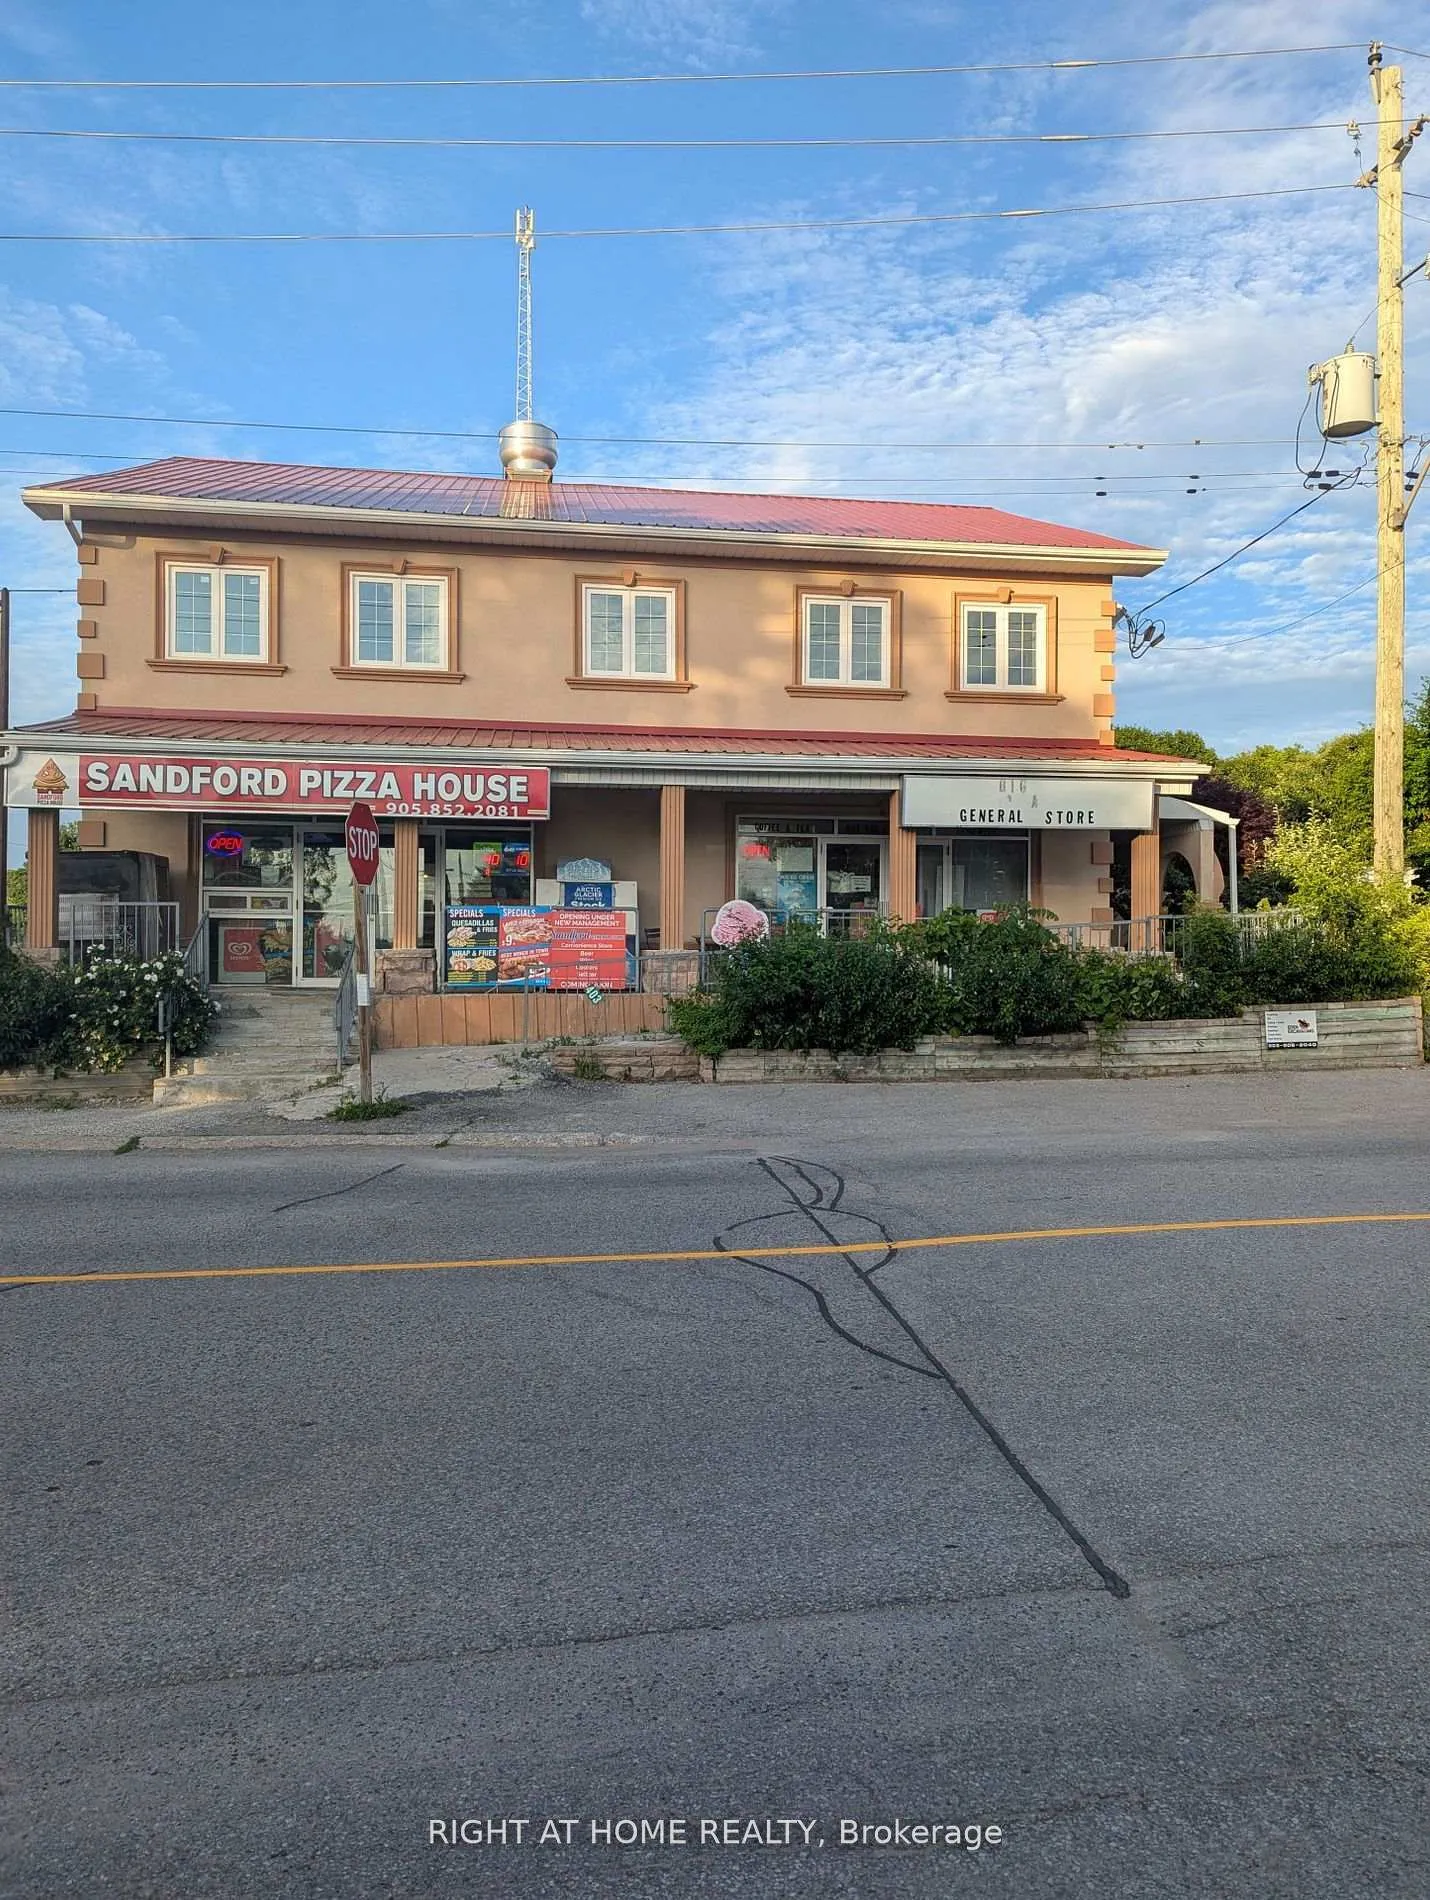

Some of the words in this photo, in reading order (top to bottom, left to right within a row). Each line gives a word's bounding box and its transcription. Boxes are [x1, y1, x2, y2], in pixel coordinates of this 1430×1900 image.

[85, 762, 288, 796] SANDFORD
[299, 769, 402, 800] PIZZA
[414, 772, 529, 803] HOUSE
[386, 802, 519, 817] 905.852.2081
[959, 808, 1023, 823] GENERAL
[1045, 810, 1095, 824] STORE
[209, 838, 243, 850] OPEN
[349, 826, 377, 861] STOP
[450, 909, 484, 918] SPECIALS
[503, 908, 536, 918] SPECIALS
[451, 919, 494, 927] QUESADILLAS
[585, 986, 602, 1004] 403
